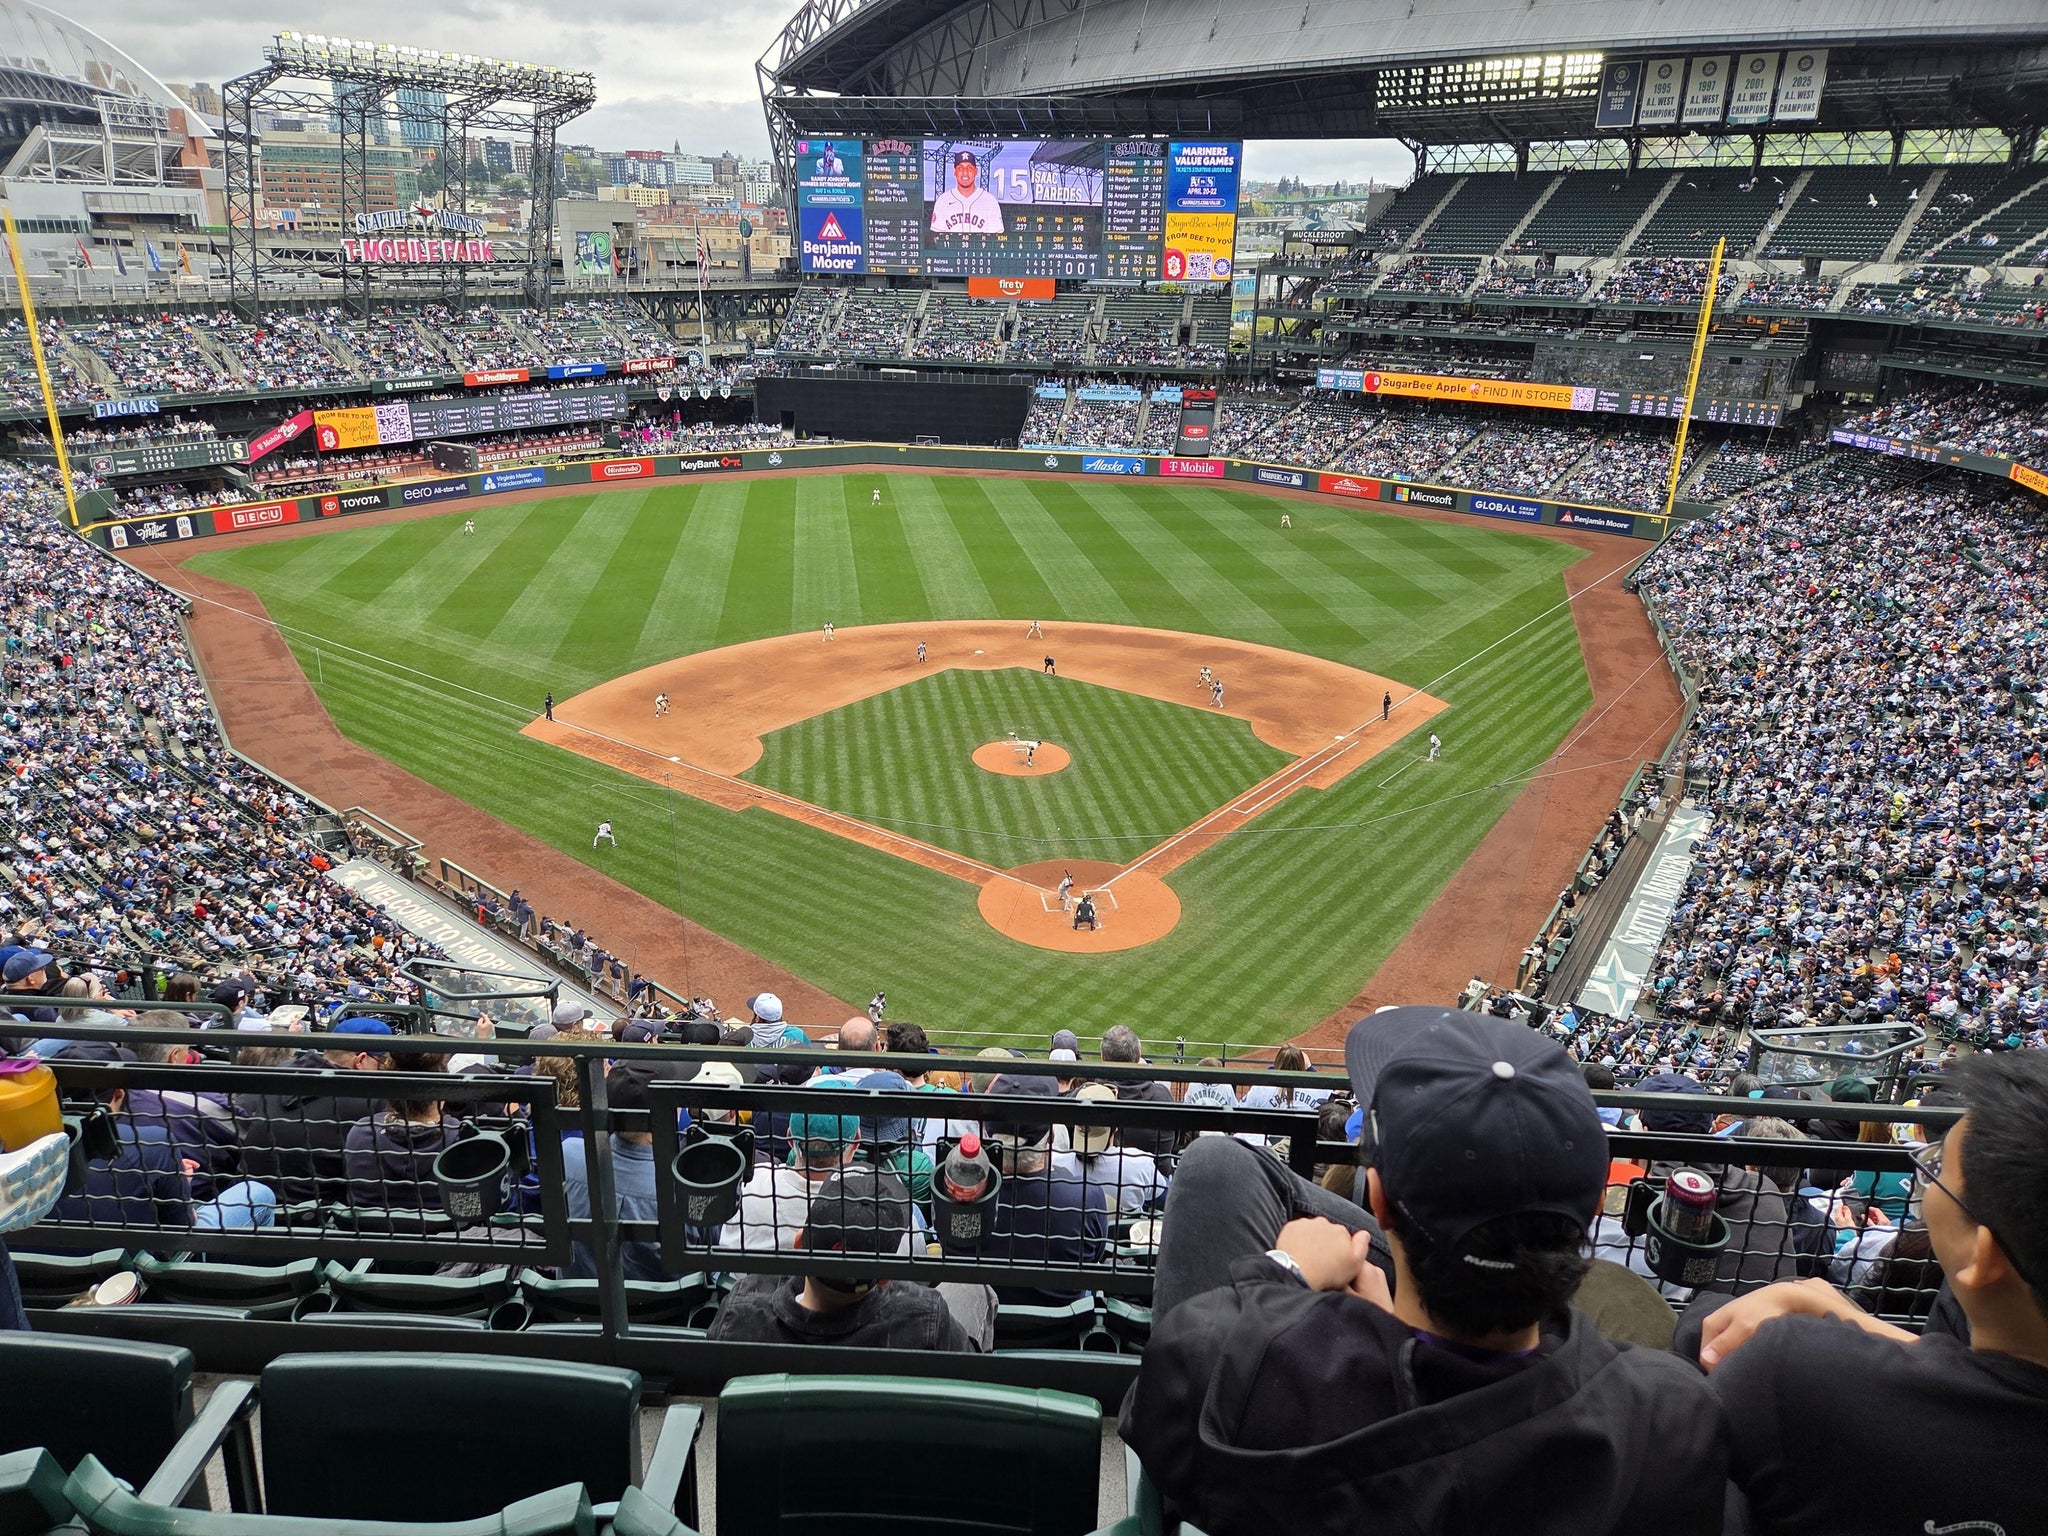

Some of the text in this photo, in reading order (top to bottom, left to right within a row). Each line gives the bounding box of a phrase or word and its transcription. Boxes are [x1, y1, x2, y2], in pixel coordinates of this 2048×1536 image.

[1698, 80, 1716, 91] 1997
[1745, 78, 1764, 90] 2001
[1792, 76, 1813, 87] 2025
[1654, 83, 1672, 94] 1995
[1784, 88, 1815, 100] A.L. WEST
[1646, 96, 1675, 106] A.L. WEST
[1690, 94, 1719, 104] A.L. WEST
[1737, 92, 1767, 102] A.L. WEST
[1640, 109, 1676, 119] CHAMPIONS
[1684, 106, 1720, 117] CHAMPIONS
[1731, 105, 1768, 115] CHAMPIONS
[1778, 102, 1816, 113] CHAMPIONS
[872, 139, 912, 156] ASTROS
[1115, 141, 1161, 157] SEATTLE
[1182, 147, 1228, 156] MARINERS
[1175, 156, 1235, 166] VALUE GAMES
[1031, 168, 1058, 185] ISAAC
[993, 168, 1028, 201] 15
[1035, 183, 1082, 202] PAREDES
[356, 208, 485, 236] SEATTLE MARINERS
[945, 213, 986, 230] ASTROS
[1208, 216, 1233, 231] Apple
[1167, 233, 1188, 242] FROM
[1190, 234, 1204, 242] BEE
[341, 239, 496, 263] T-MOBILE PARK
[803, 240, 862, 258] Benjamin
[812, 255, 855, 270] Moore
[1066, 262, 1072, 275] 0
[1078, 262, 1084, 275] 0
[1090, 262, 1095, 275] 1
[998, 279, 1024, 289] fire tv
[394, 380, 434, 389] STARBUCKS
[1338, 378, 1361, 389] $9,555
[1382, 377, 1572, 403] SugarBee Apple FIND IN STORES
[661, 390, 668, 398] 42
[95, 399, 160, 418] EDGARS
[318, 412, 336, 422] FROM
[264, 422, 298, 448] Mobile Pen
[232, 442, 243, 458] S
[478, 452, 511, 462] BIGGEST
[520, 449, 537, 458] BEST
[548, 446, 560, 454] THE
[607, 465, 639, 474] Nintendo
[680, 458, 720, 471] KeyBank
[1085, 458, 1124, 472] Alaska
[1170, 461, 1215, 473] T Mobile
[497, 479, 524, 488] Franciscan
[404, 485, 456, 500] eero All-star
[1410, 490, 1453, 506] Microsoft
[341, 495, 381, 509] TOYOTA
[1475, 500, 1517, 514] GLOBAL
[237, 511, 279, 525] BECU
[1574, 515, 1629, 529] Benjamin Moore
[151, 530, 168, 539] TIME
[1639, 852, 1691, 904] MARINERS
[363, 880, 460, 943] WELCOME TO
[1269, 1090, 1319, 1109] CRAFORD
